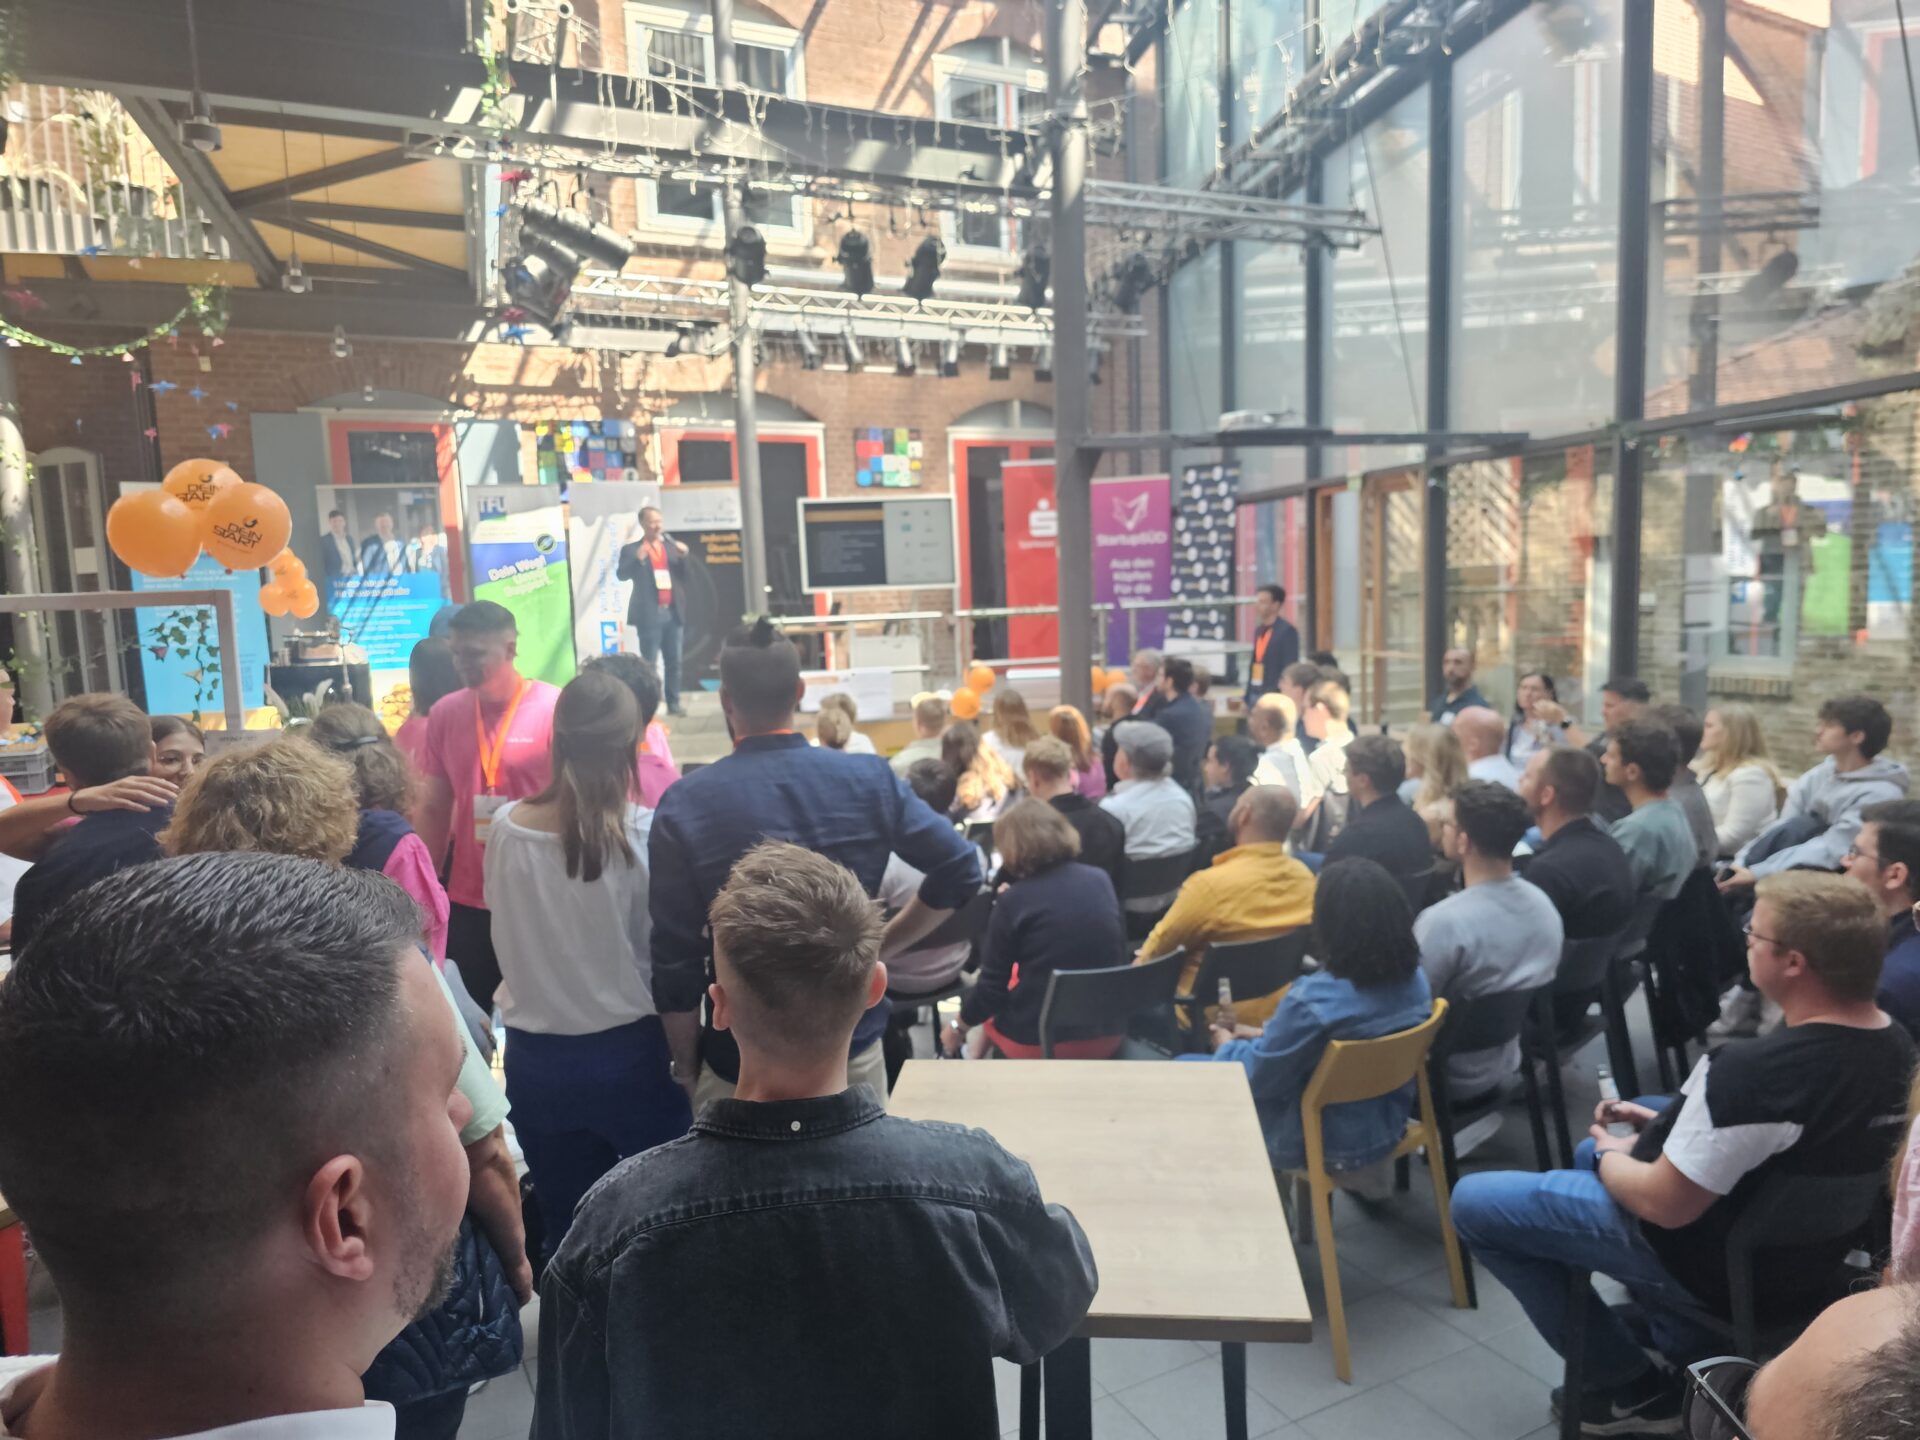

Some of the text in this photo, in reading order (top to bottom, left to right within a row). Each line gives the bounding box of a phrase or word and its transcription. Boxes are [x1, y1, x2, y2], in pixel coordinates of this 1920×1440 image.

[176, 491, 211, 502] STAR
[213, 525, 258, 549] START
[228, 523, 263, 543] DEIN
[1109, 559, 1131, 569] Aus
